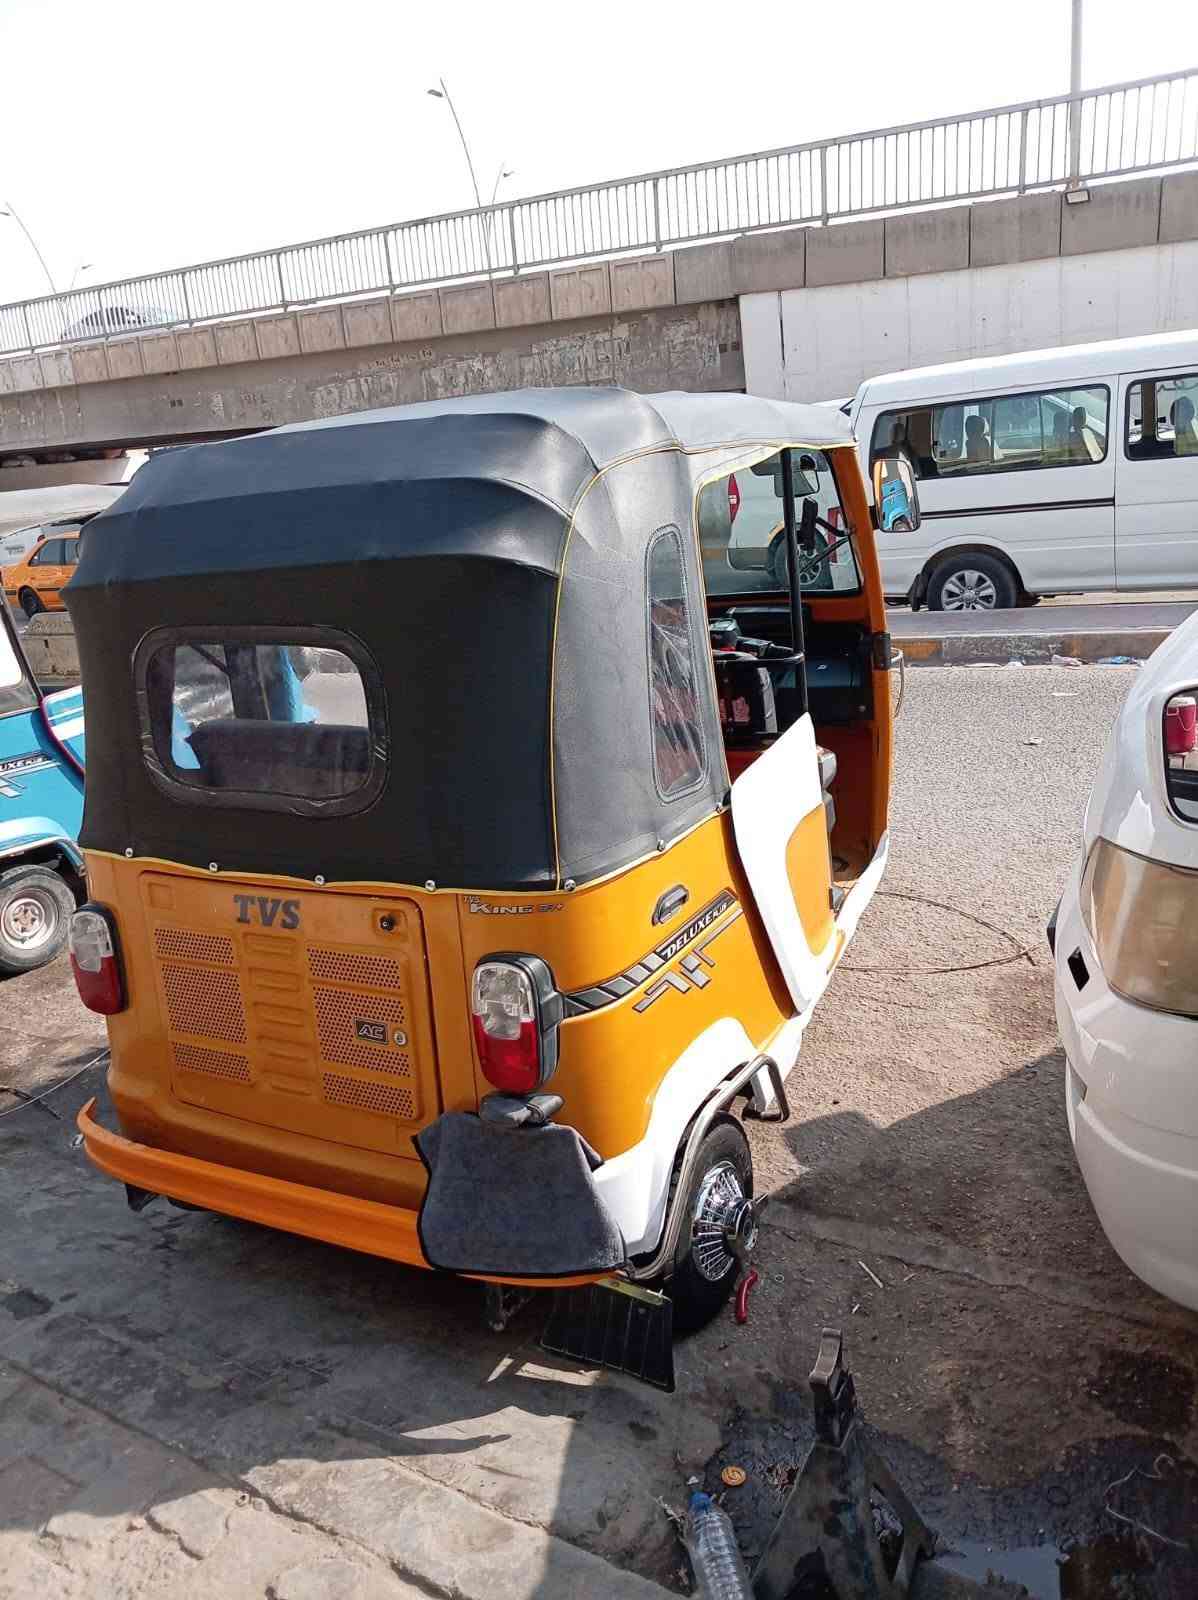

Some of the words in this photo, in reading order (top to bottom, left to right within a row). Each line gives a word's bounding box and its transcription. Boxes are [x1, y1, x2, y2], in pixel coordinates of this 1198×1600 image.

[233, 894, 300, 929] TVS
[470, 902, 533, 914] KING
[661, 910, 713, 958] DELUXE
[358, 1023, 386, 1040] AC
